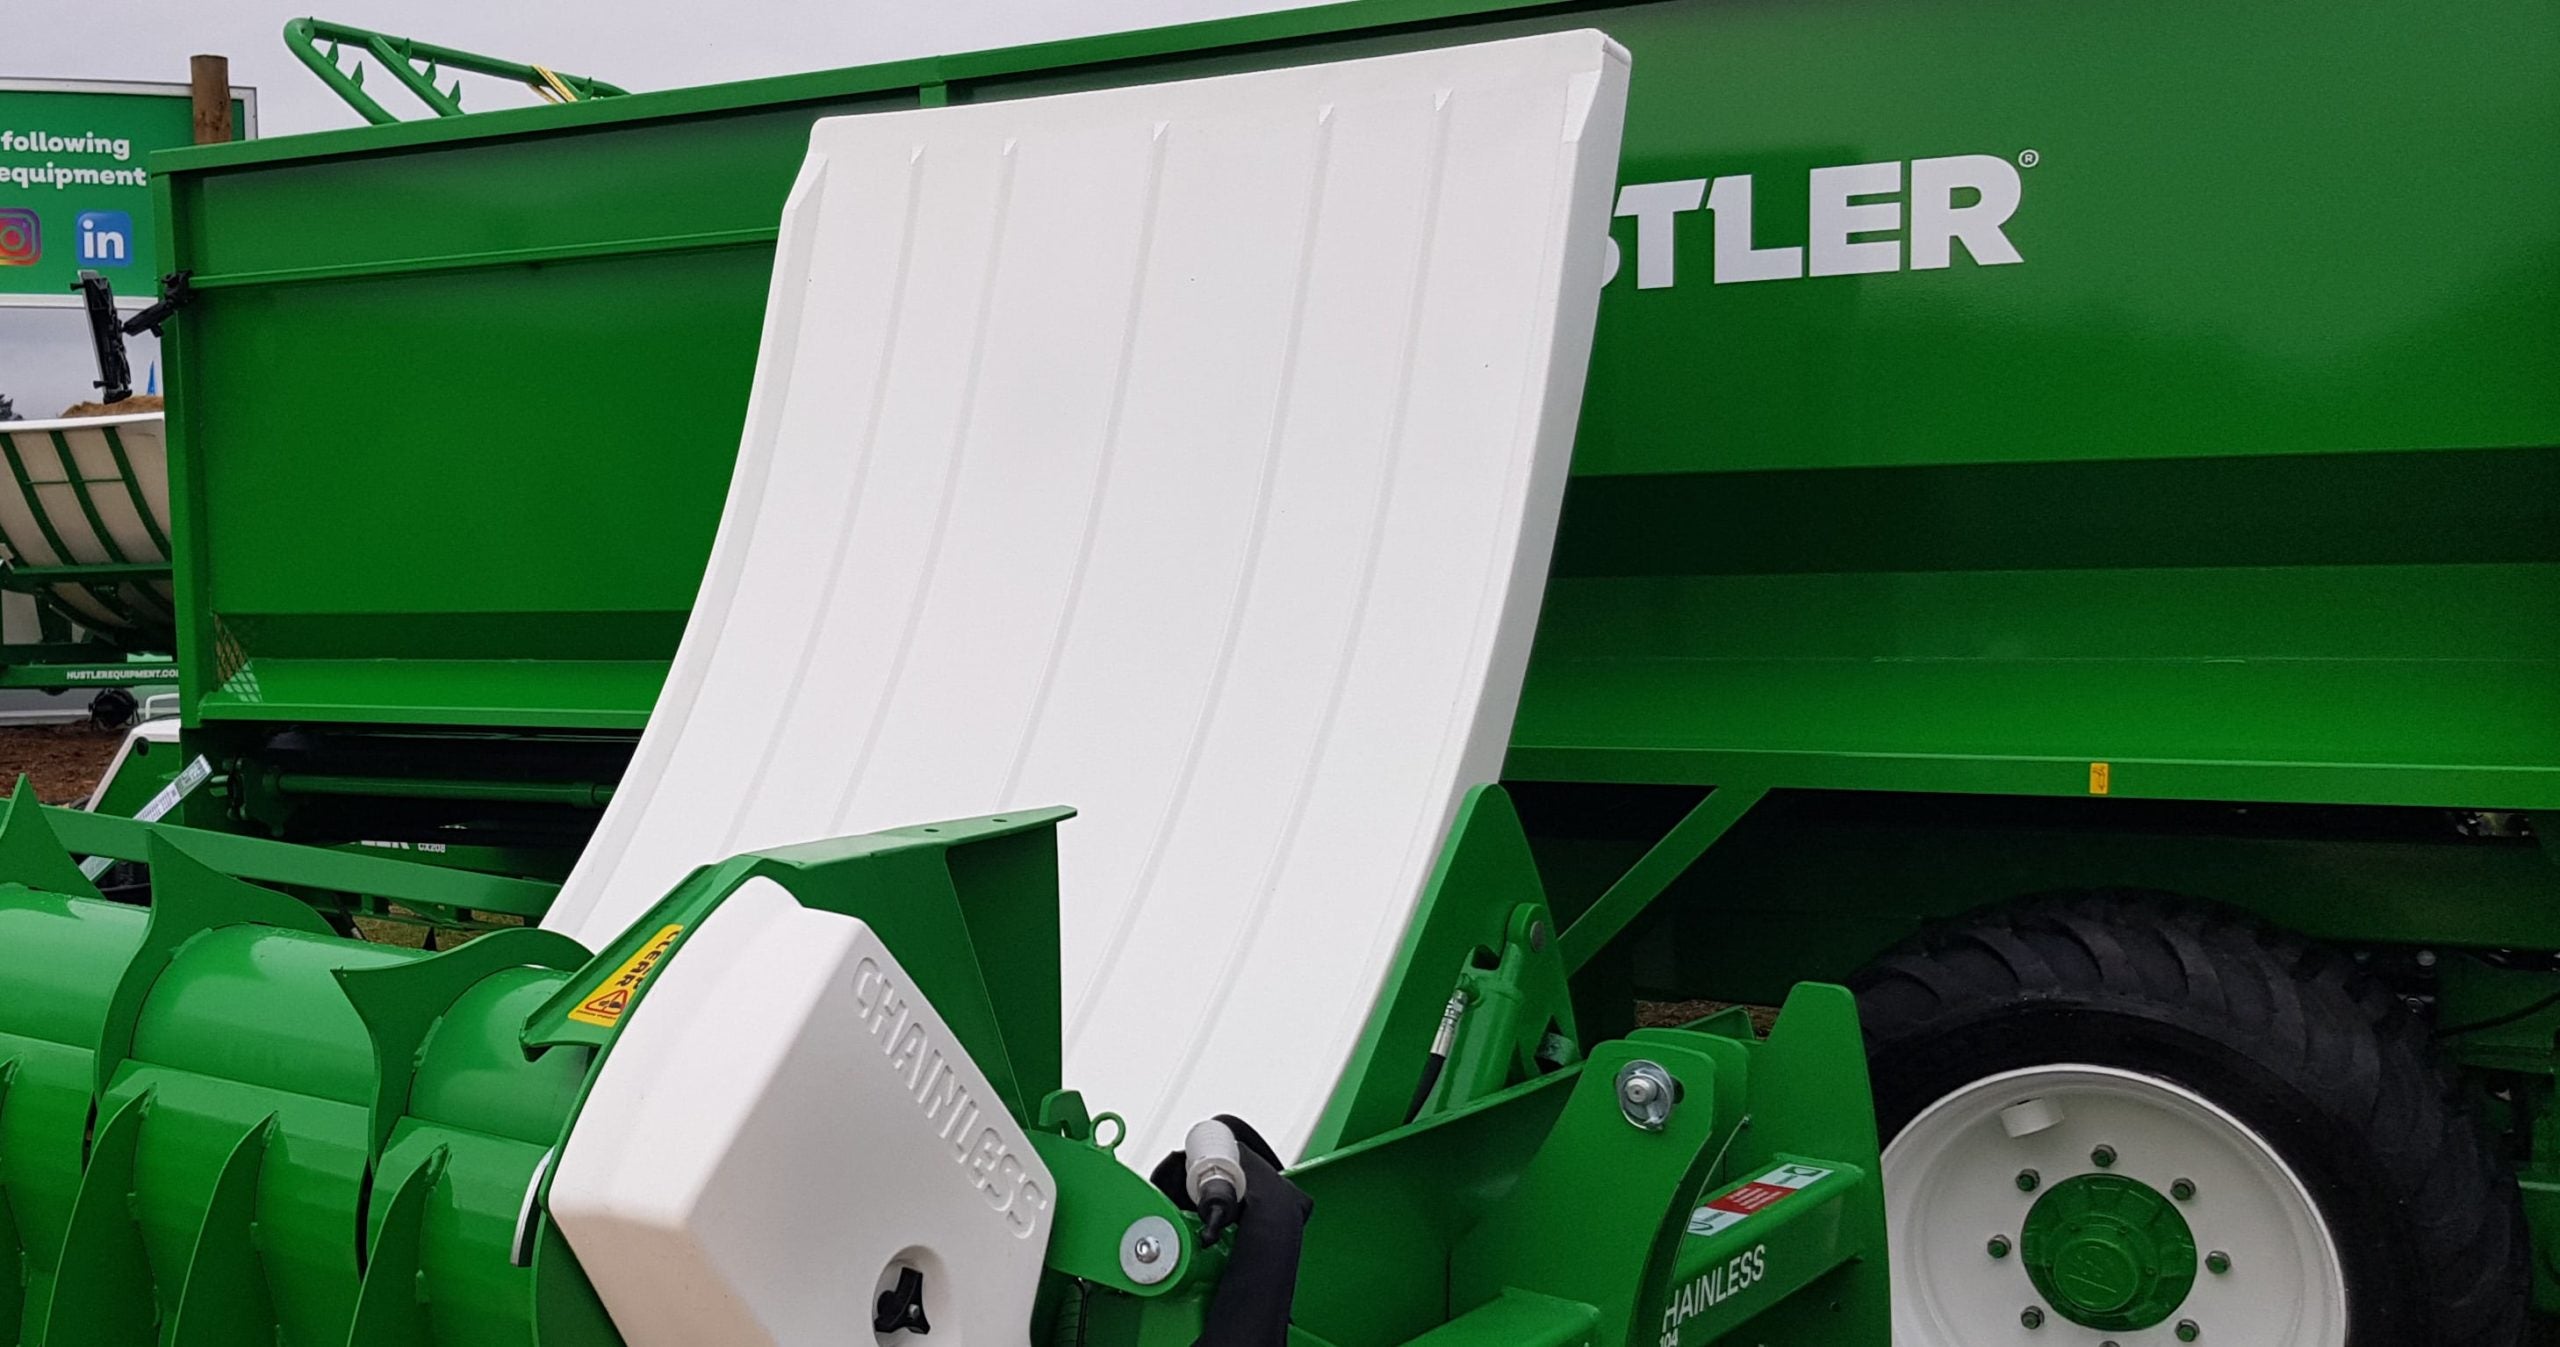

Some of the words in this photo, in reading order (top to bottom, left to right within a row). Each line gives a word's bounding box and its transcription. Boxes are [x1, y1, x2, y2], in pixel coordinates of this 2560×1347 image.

[1, 130, 130, 160] following
[0, 161, 147, 189] equipment
[851, 956, 1048, 1239] CHAINLESS
